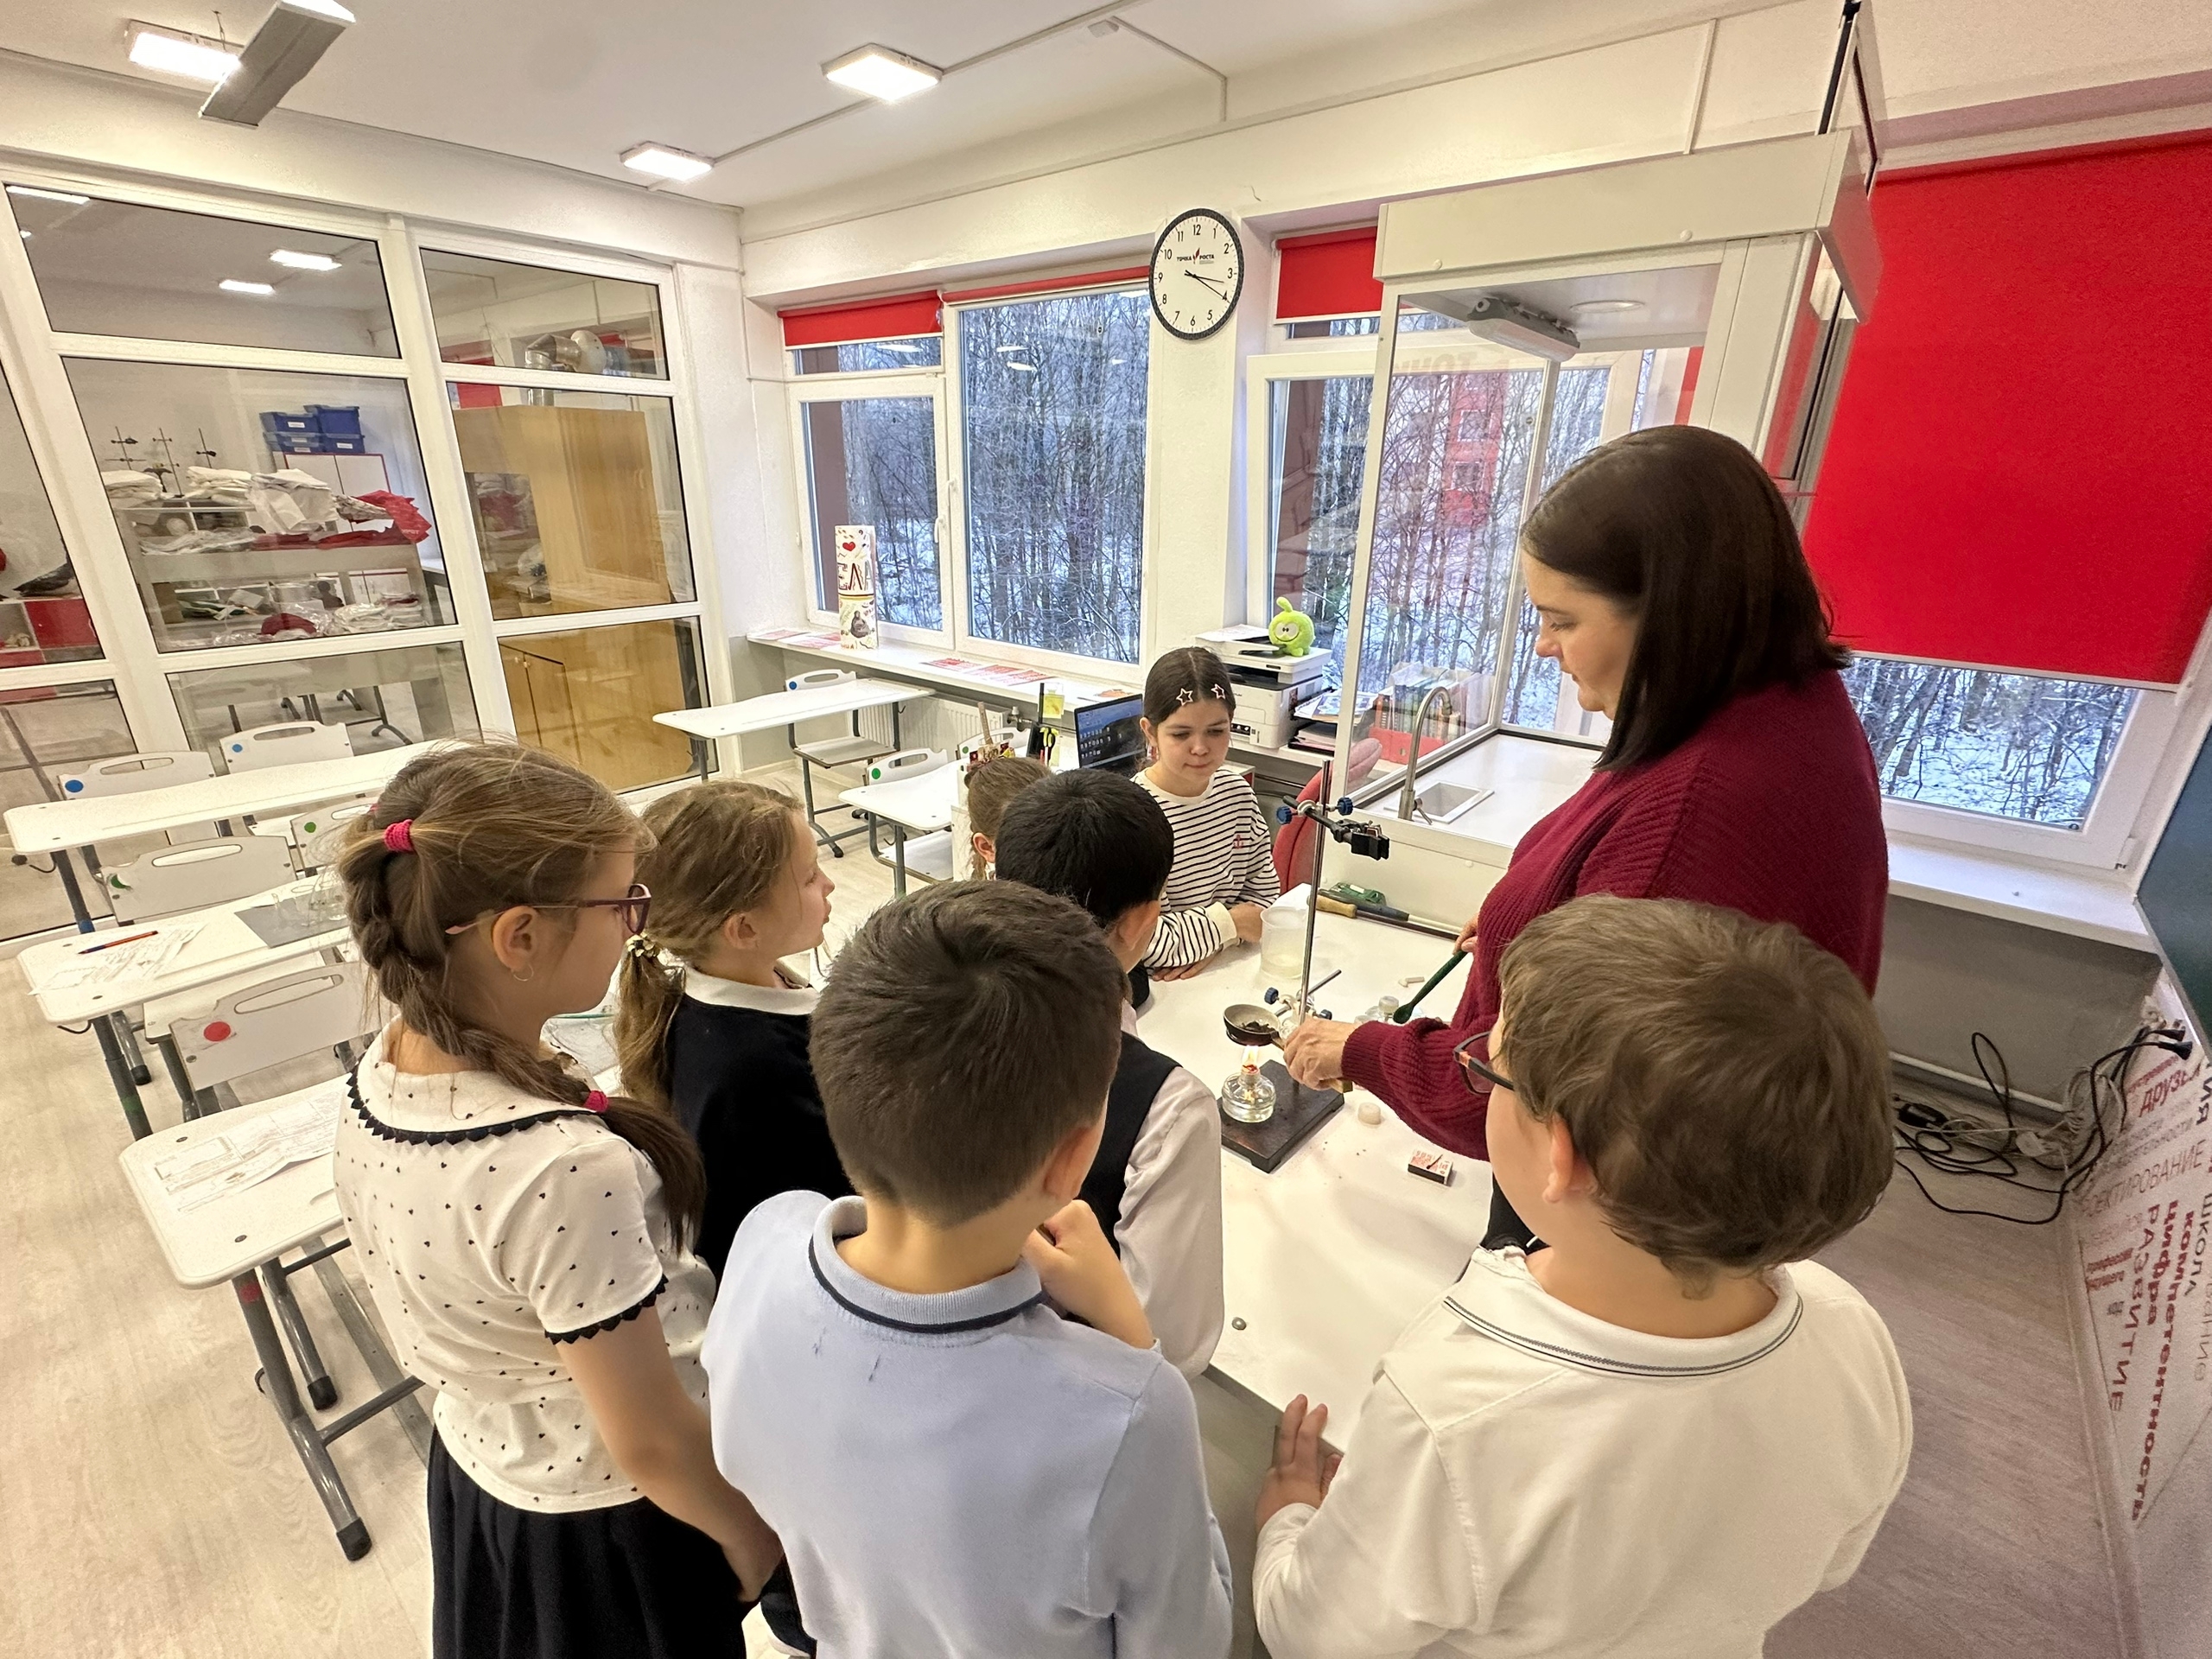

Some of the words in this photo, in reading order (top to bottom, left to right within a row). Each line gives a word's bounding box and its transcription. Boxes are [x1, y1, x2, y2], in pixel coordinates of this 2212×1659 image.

[1192, 224, 1201, 236] 12
[1177, 231, 1184, 242] 11
[1164, 249, 1173, 260] 10
[1224, 243, 1230, 255] 2
[1158, 271, 1163, 283] 9
[1227, 267, 1233, 279] 3
[1162, 294, 1167, 305] 8
[1172, 310, 1180, 326] 7
[1190, 315, 1196, 327] 6
[1207, 309, 1213, 321] 5
[2111, 1204, 2160, 1412] РАЗВИТИЕ
